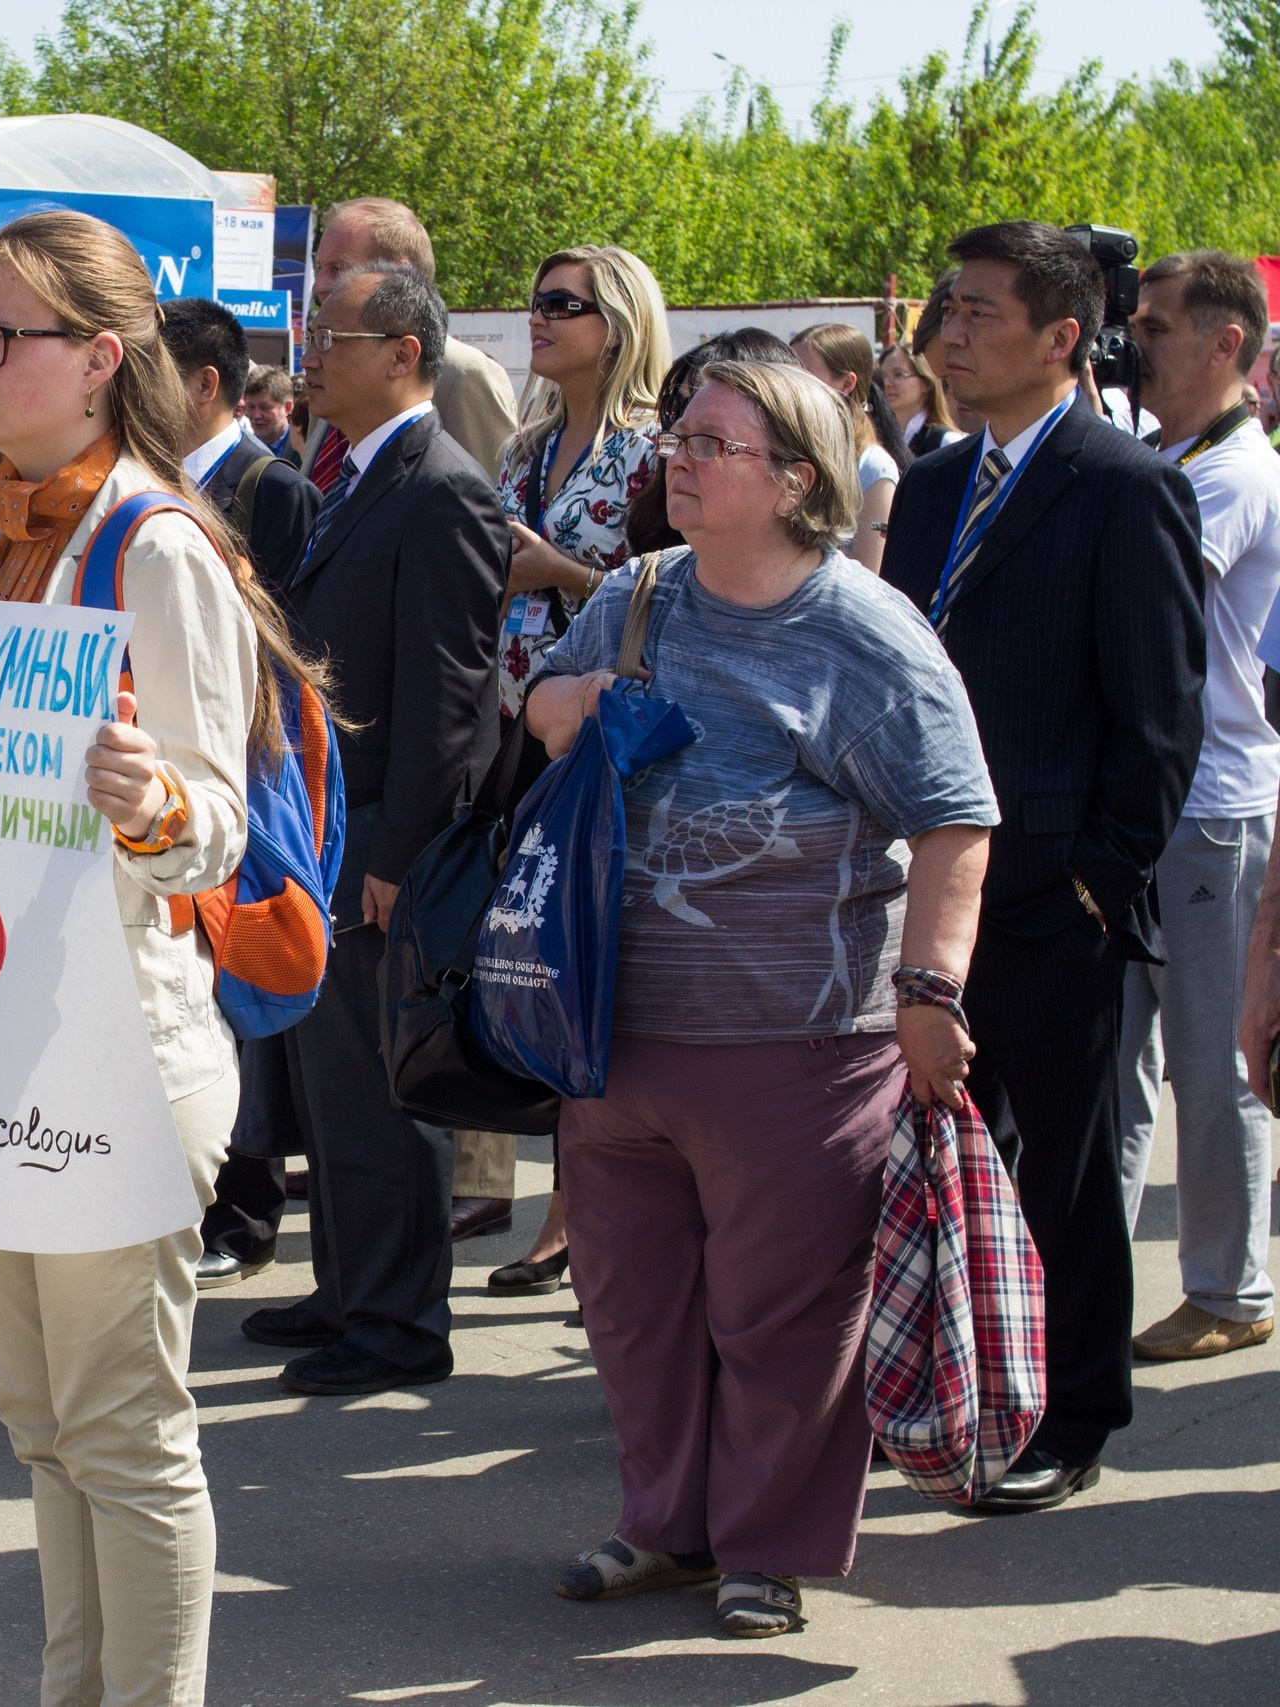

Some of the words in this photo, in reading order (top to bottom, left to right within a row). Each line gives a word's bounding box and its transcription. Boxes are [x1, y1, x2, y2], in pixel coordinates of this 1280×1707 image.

[240, 219, 264, 230] мая
[1180, 439, 1212, 465] Nikon
[527, 605, 542, 617] VIP
